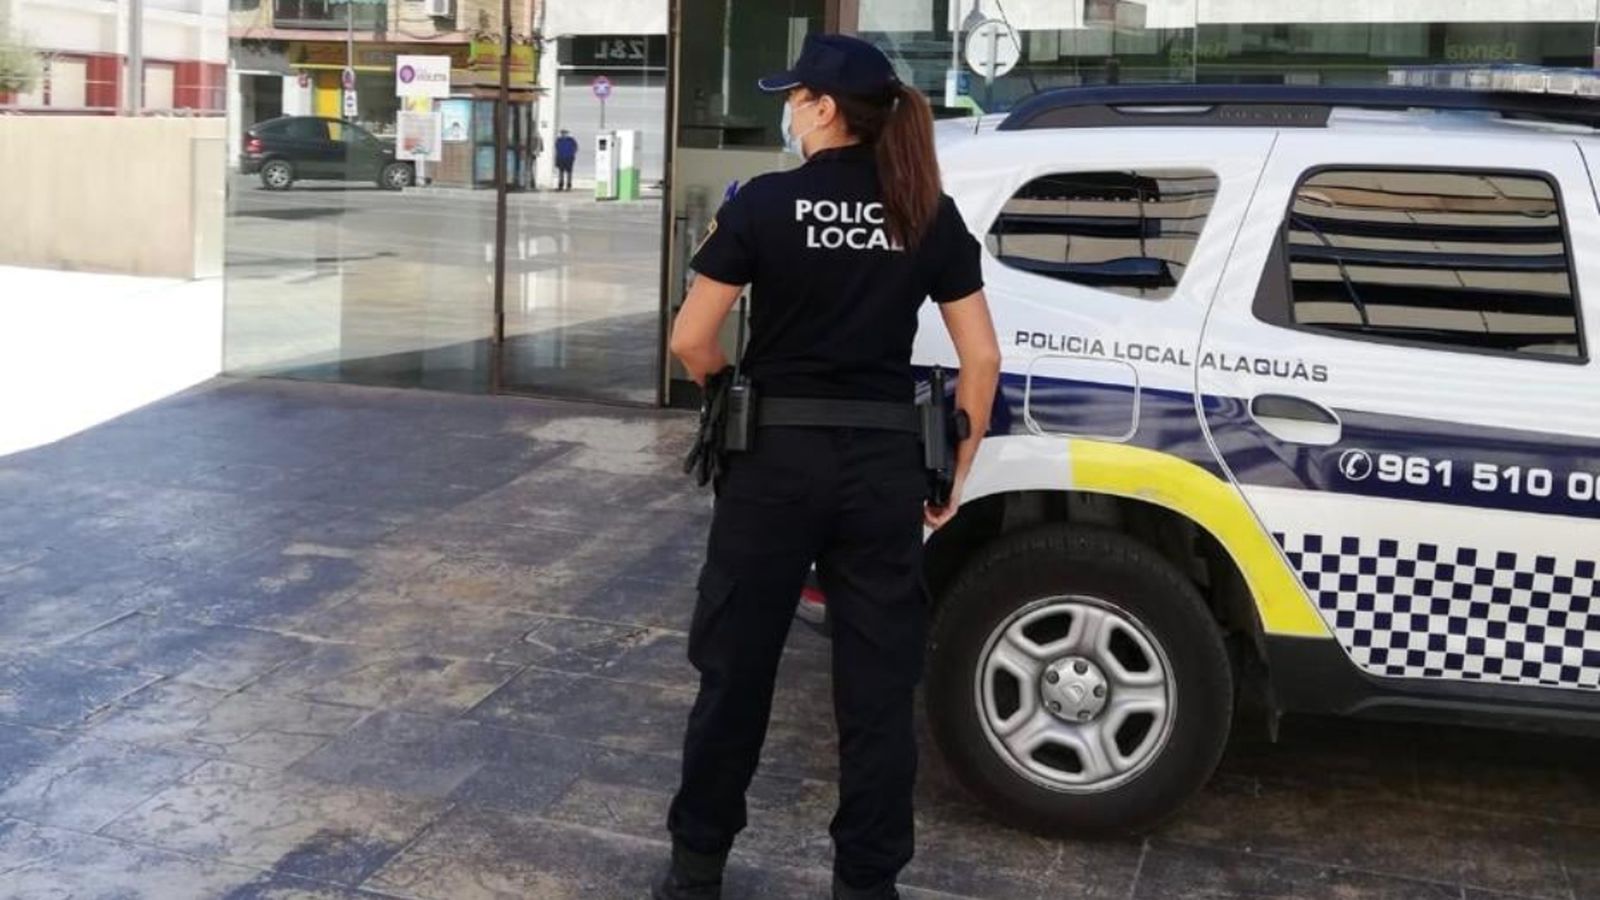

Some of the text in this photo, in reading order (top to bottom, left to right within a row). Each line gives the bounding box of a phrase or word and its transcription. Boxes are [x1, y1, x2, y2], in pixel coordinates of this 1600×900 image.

[795, 198, 885, 224] POLIC
[806, 226, 904, 251] LOCAL
[1014, 331, 1329, 382] POLICIA LOCAL ALAQUÀS
[1377, 453, 1600, 501] 961 510 0
